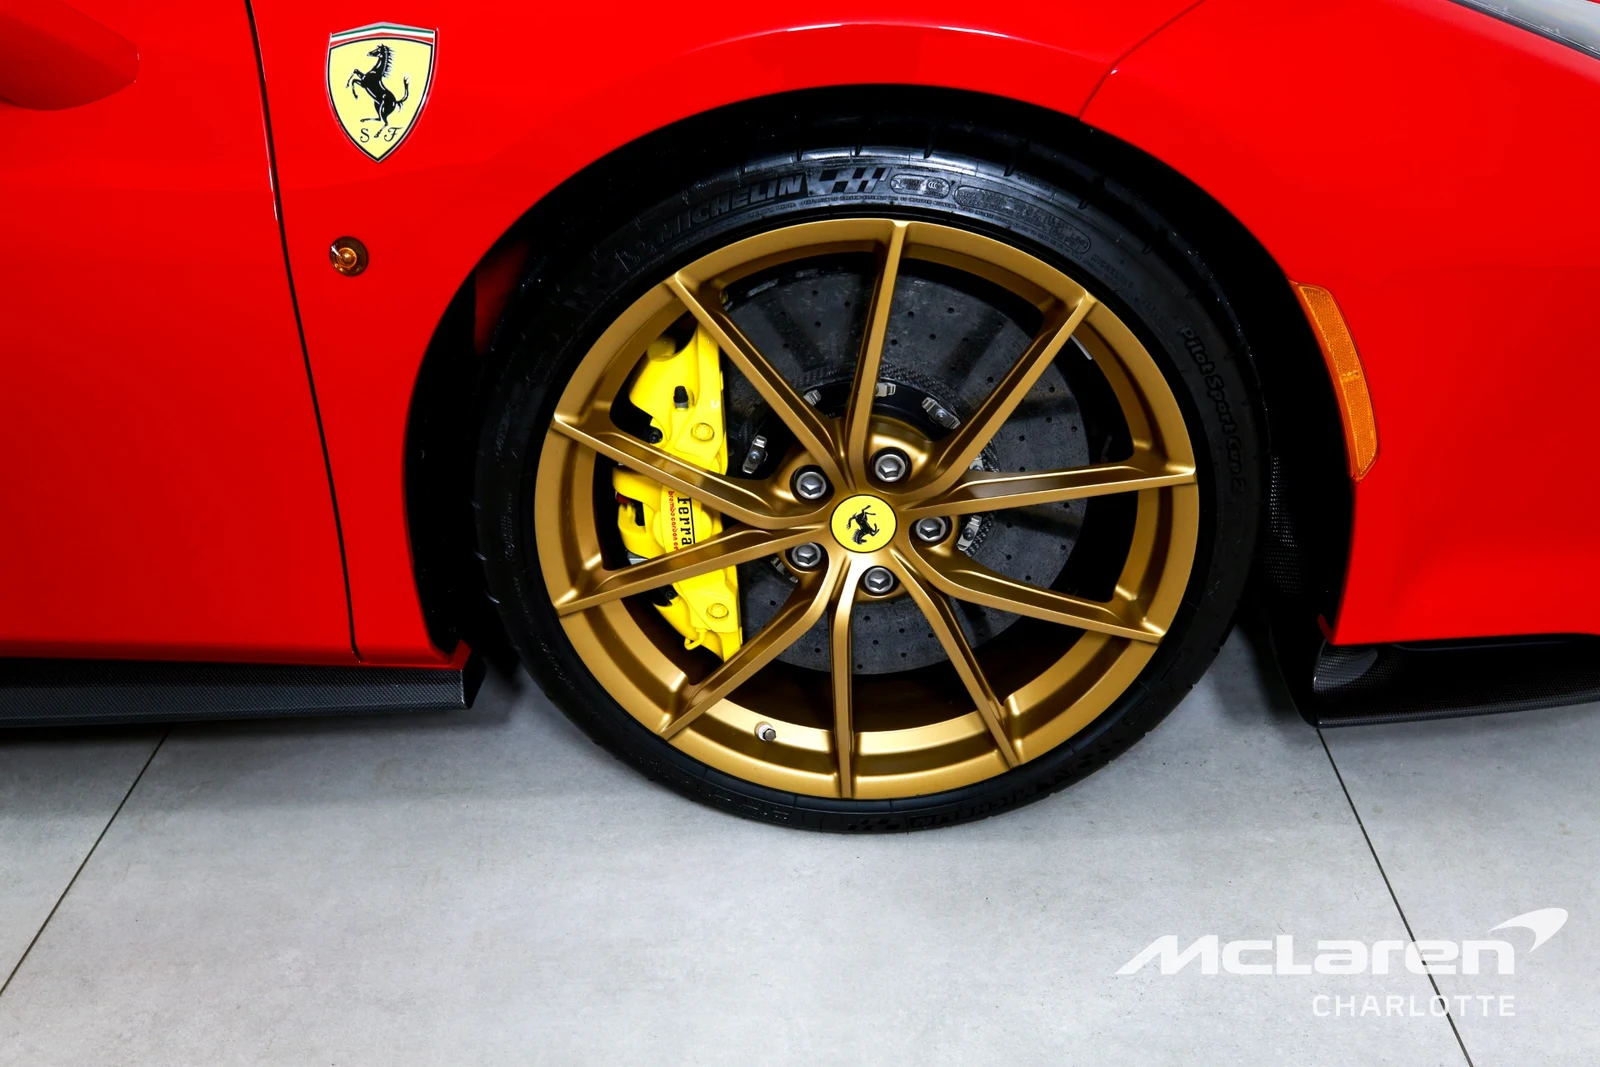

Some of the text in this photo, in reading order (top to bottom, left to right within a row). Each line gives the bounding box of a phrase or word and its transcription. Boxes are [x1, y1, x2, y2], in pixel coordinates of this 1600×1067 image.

[359, 127, 403, 143] S F
[659, 174, 806, 244] MICHELIN
[1178, 325, 1216, 376] Pilot
[1204, 374, 1237, 435] Sport
[1226, 436, 1243, 475] Cup
[677, 497, 695, 545] Ferra
